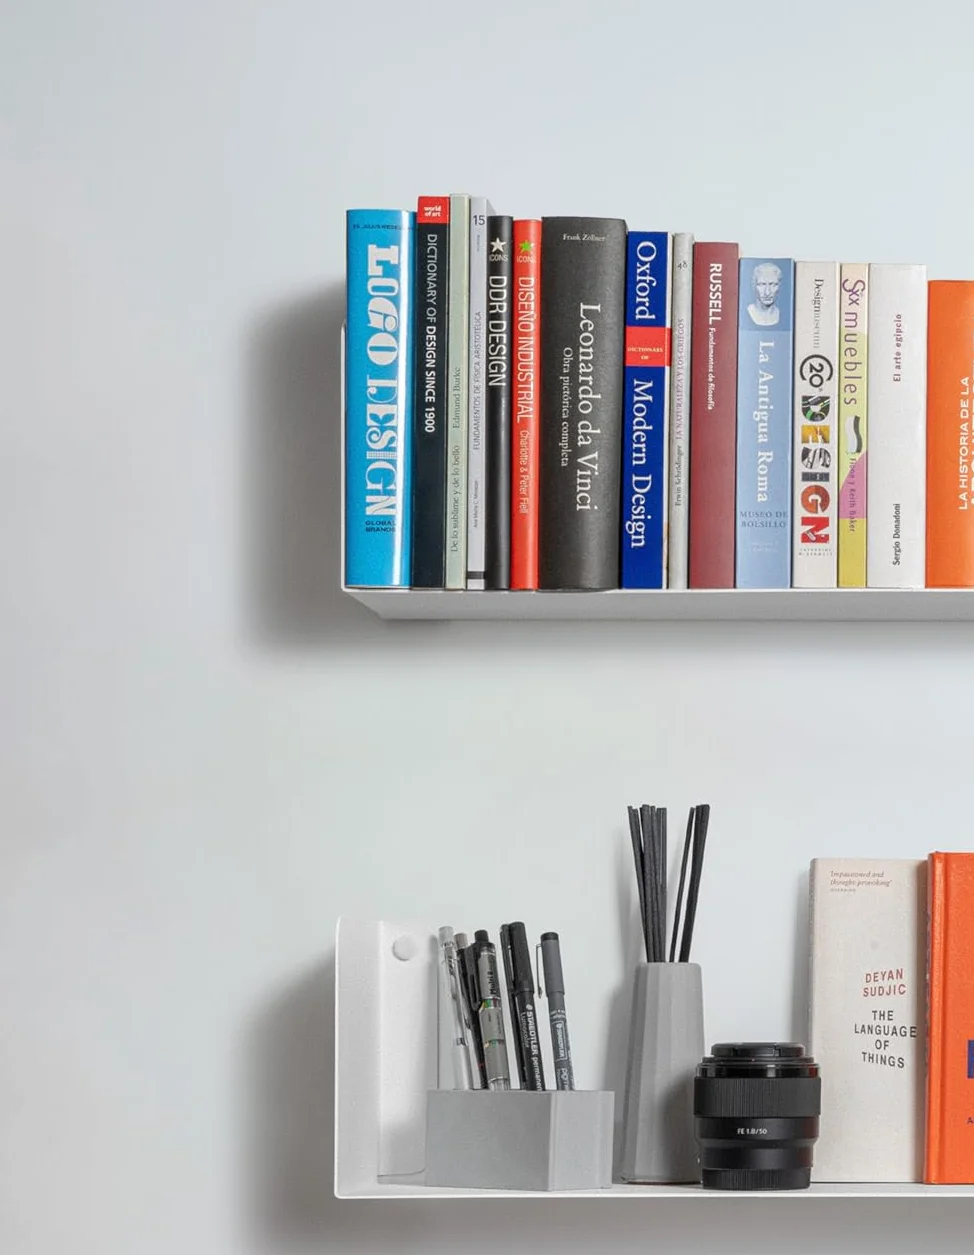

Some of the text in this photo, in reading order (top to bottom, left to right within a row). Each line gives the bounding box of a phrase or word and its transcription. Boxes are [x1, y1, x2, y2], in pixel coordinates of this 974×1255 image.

[473, 215, 486, 226] 15
[489, 254, 509, 262] ICONS
[635, 241, 657, 320] Oxford
[708, 263, 722, 325] RUSSELL
[812, 279, 824, 349] Designmuseum
[424, 234, 437, 433] DICTIONARY OF DESIGN SINCE 1900
[488, 276, 508, 387] DDR DESIGN
[516, 277, 537, 424] DISEÑO INDUSTRIAL
[676, 318, 685, 354] GRIEGOS
[708, 327, 716, 373] Fundamentos
[892, 314, 903, 382] El arte egipcio
[365, 244, 399, 516] LOGO DESIGN
[707, 374, 716, 382] de
[843, 311, 863, 406] muebles
[453, 367, 461, 429] Edmund Burke
[474, 384, 481, 395] DE
[558, 347, 573, 467] Obra pictórica completa
[576, 302, 601, 512] Leonardo da Vinci
[473, 395, 481, 450] FUNDAMENTOS
[752, 341, 775, 504] La Antigua Roma
[958, 376, 970, 511] LA HISTORIA DE LA
[519, 430, 530, 466] Charlotte
[625, 379, 654, 549] Modern Design
[801, 395, 832, 544] DESIGN
[451, 445, 461, 552] De lo sublime y de lo bello
[519, 476, 530, 496] Peter
[849, 488, 858, 508] Keith
[740, 511, 788, 519] MUSEO DE
[741, 520, 787, 528] BOLSILLO
[849, 511, 858, 533] Baker
[892, 503, 902, 566] Sergio Donadoni
[863, 983, 907, 997] SUDJIC
[865, 968, 904, 983] DEYAN
[526, 1011, 539, 1055] STAEDTLER
[854, 1023, 918, 1038] LANGUAGE
[872, 1010, 894, 1021] THE
[861, 1051, 905, 1069] THINGS
[874, 1039, 890, 1051] OF
